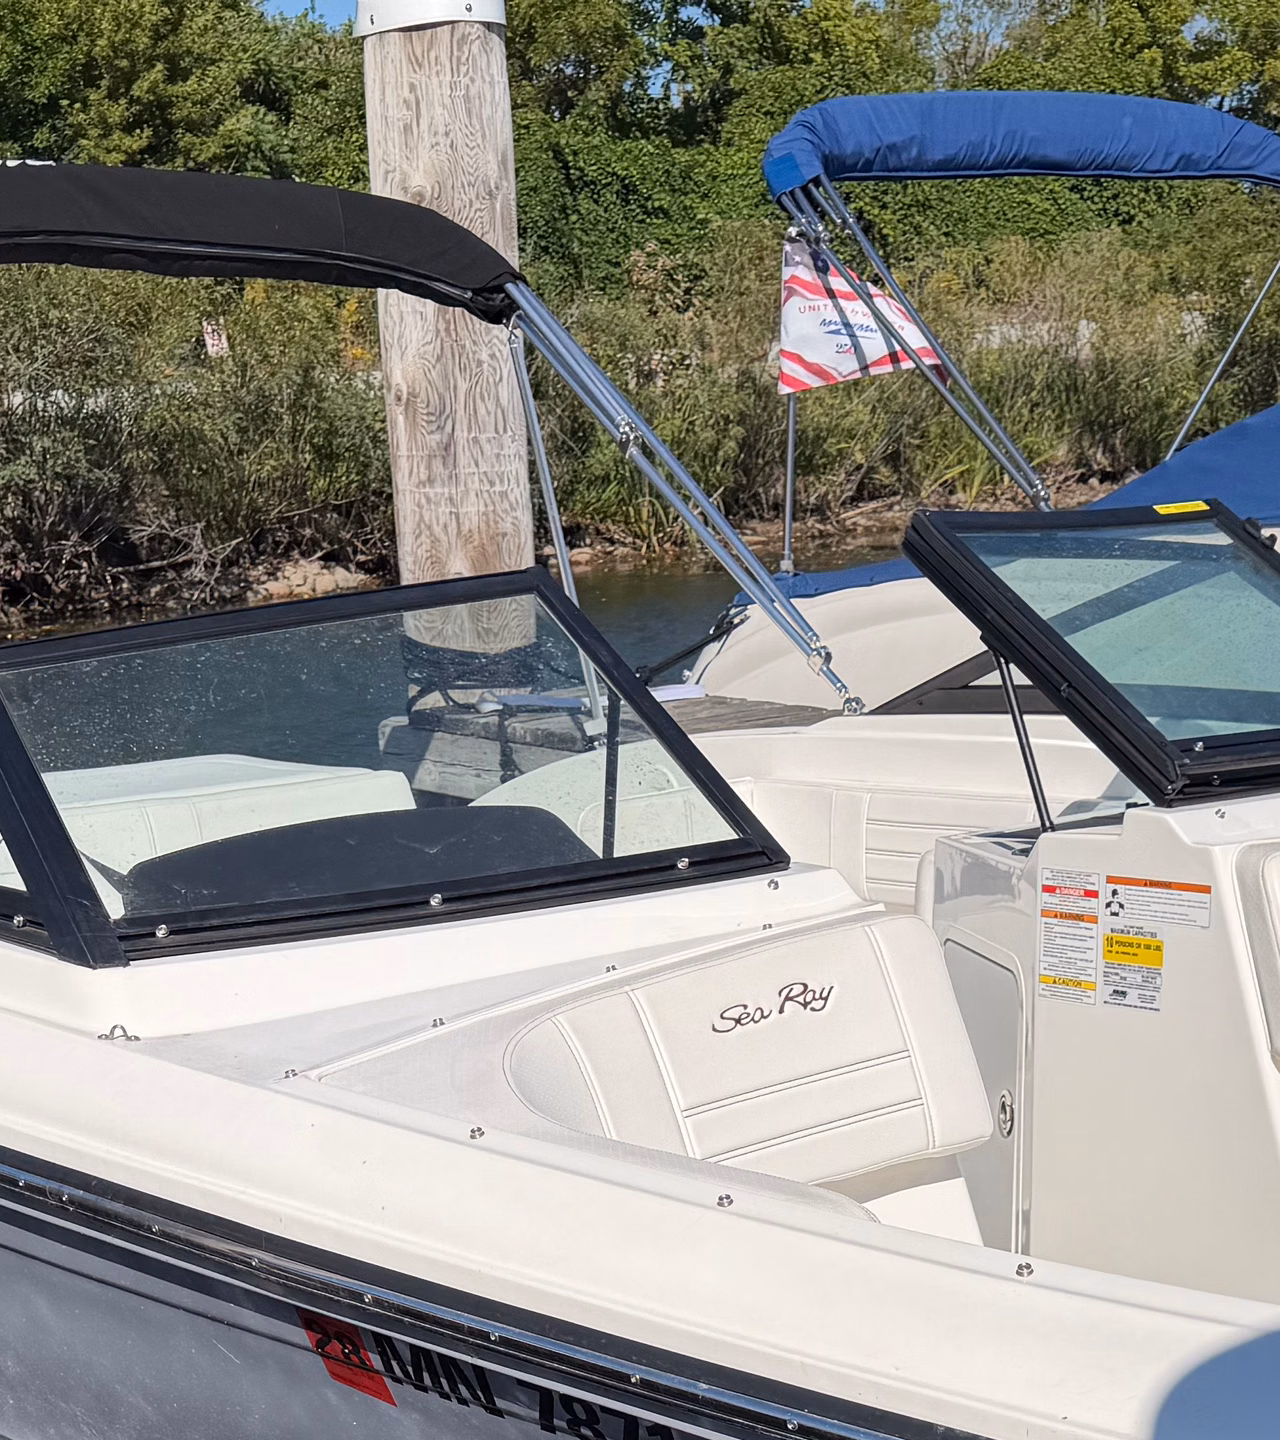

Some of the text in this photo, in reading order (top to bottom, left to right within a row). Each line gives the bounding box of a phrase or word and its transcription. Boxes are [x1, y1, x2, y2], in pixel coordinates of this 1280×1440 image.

[712, 982, 834, 1034] Sea Ray
[371, 1331, 506, 1419] MN
